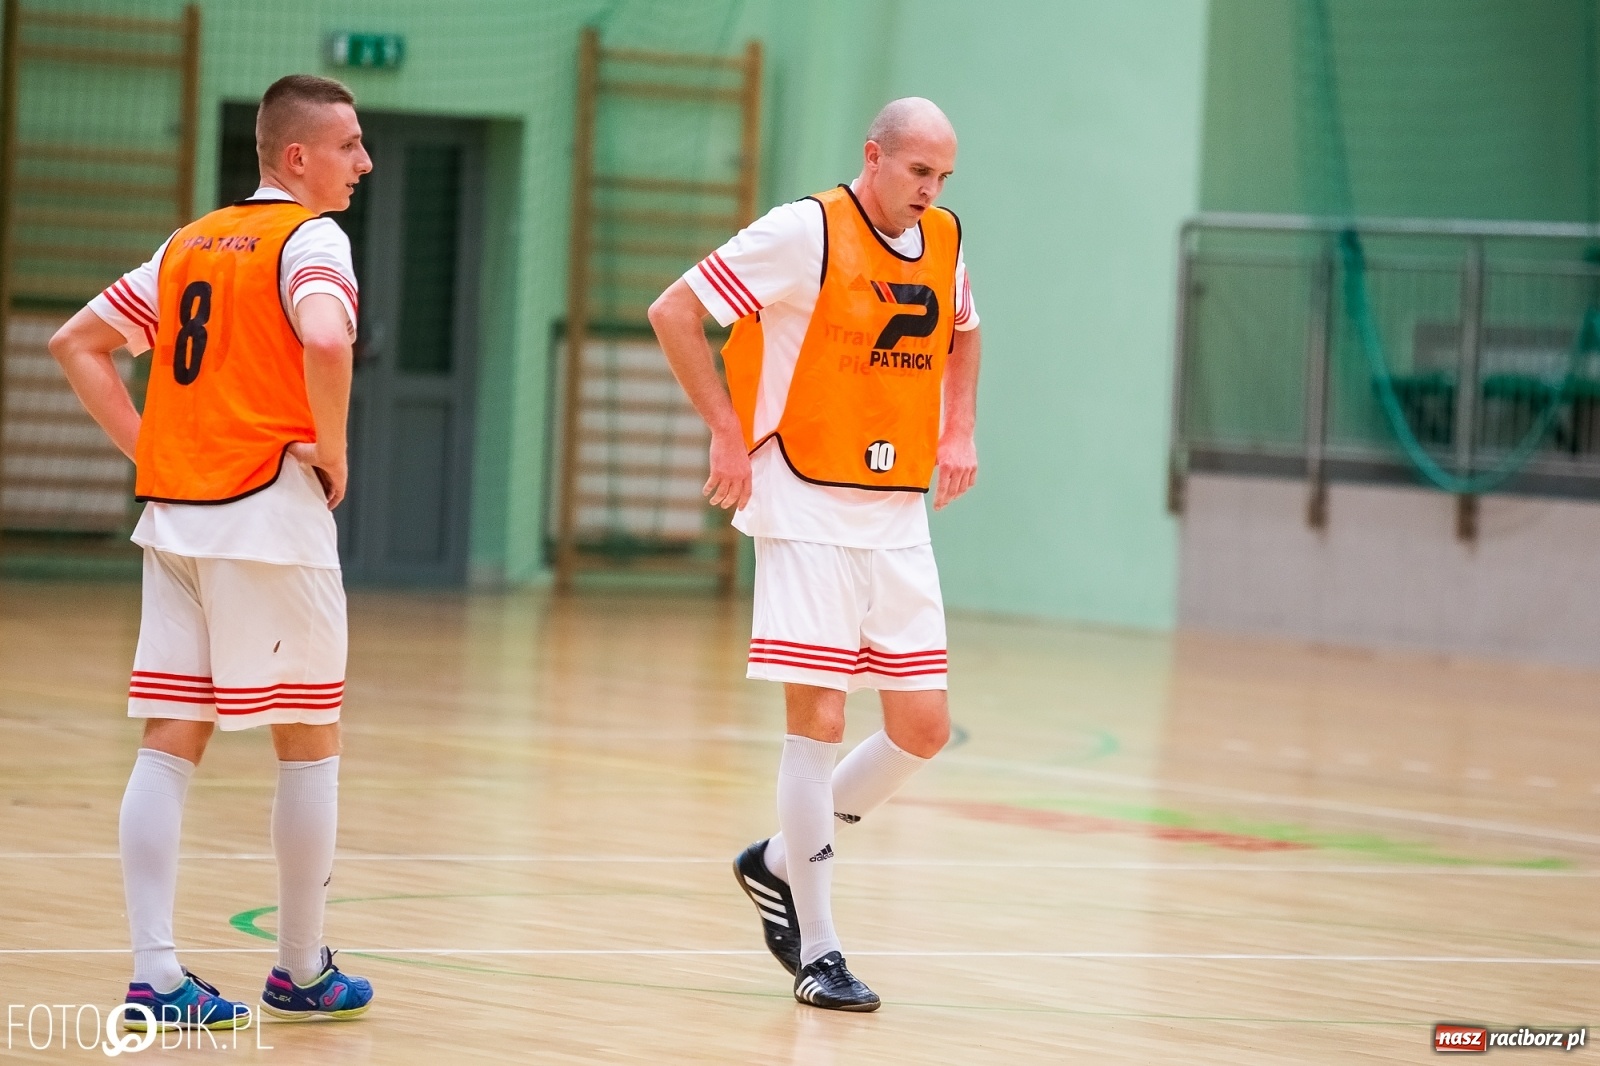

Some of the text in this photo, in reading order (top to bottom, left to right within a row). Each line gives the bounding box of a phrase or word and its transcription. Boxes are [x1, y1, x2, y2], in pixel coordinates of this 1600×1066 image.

[173, 281, 212, 386] 8
[869, 350, 933, 371] PATRICK
[868, 442, 895, 471] 10
